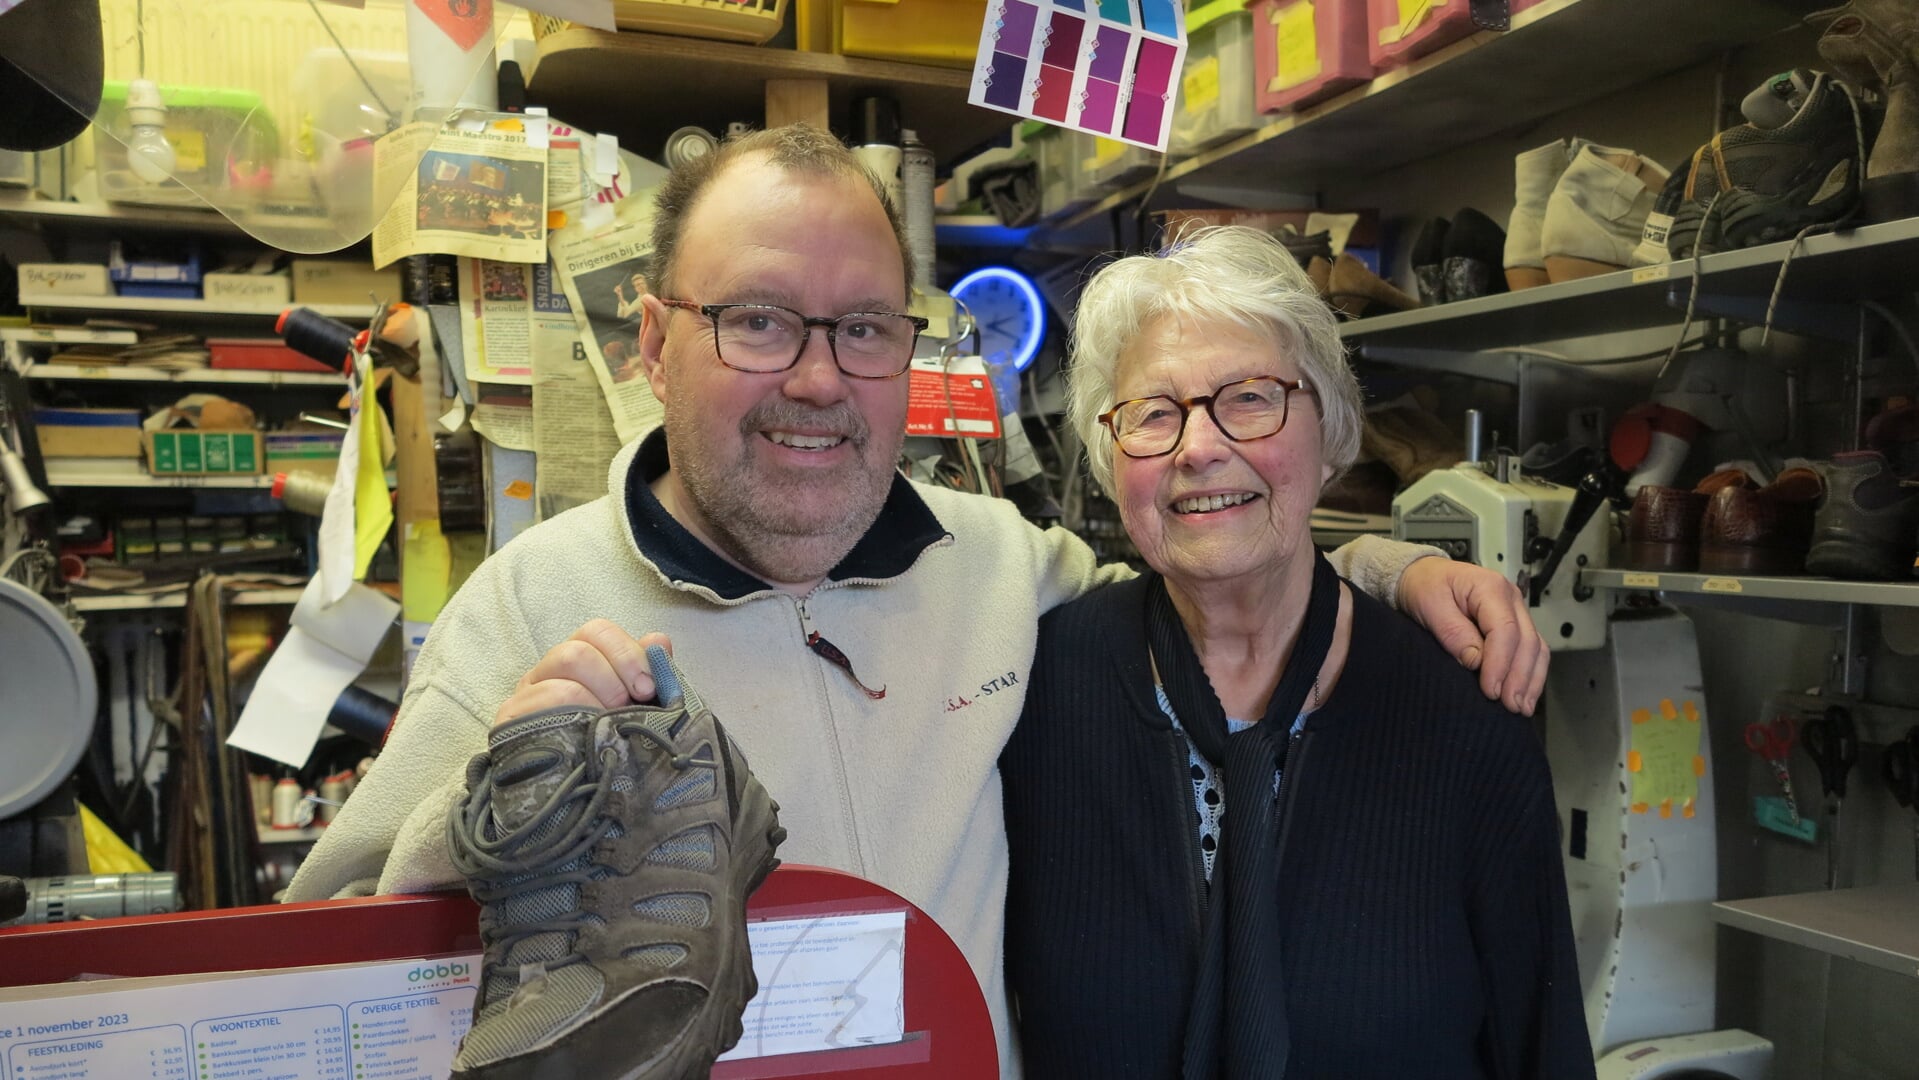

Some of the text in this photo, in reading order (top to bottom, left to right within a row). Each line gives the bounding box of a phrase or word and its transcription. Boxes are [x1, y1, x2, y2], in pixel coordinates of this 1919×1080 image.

[464, 131, 501, 142] Maestro
[504, 134, 526, 143] 2017
[568, 251, 618, 272] Dirigeren
[619, 246, 634, 260] bij
[408, 963, 469, 982] dobbi
[362, 997, 440, 1015] OVERIGE TEXTIEL
[17, 1026, 24, 1036] 1
[28, 1019, 94, 1036] november
[98, 1013, 129, 1028] 2023
[209, 1017, 281, 1033] WOONTEXTIEL
[28, 1040, 103, 1057] FEESTKLEDING
